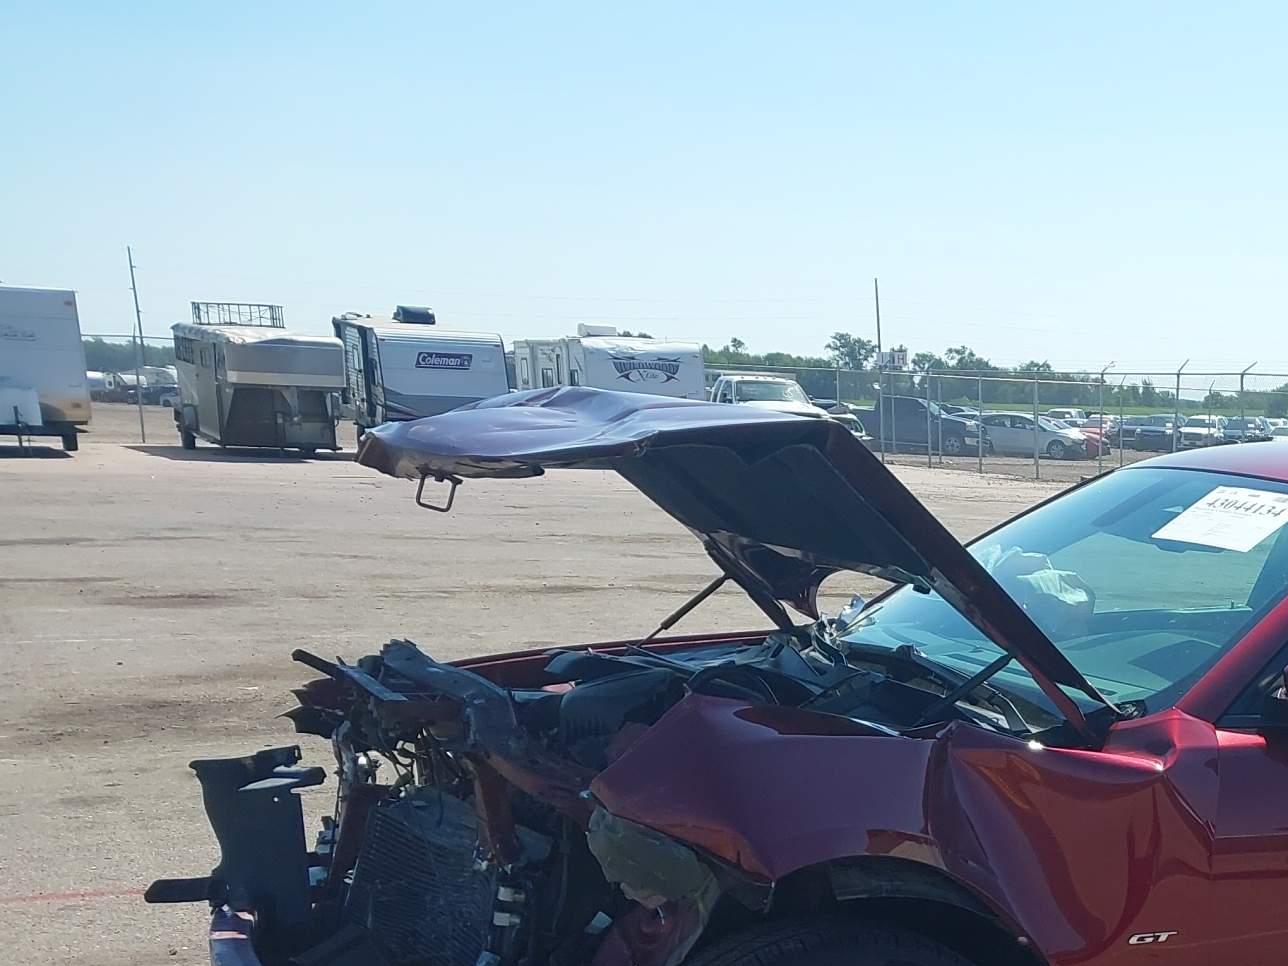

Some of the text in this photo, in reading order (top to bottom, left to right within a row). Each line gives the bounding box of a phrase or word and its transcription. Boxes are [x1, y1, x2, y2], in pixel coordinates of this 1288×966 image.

[418, 353, 461, 366] Coleman
[1206, 497, 1287, 518] 43044134
[1128, 931, 1178, 945] GT
